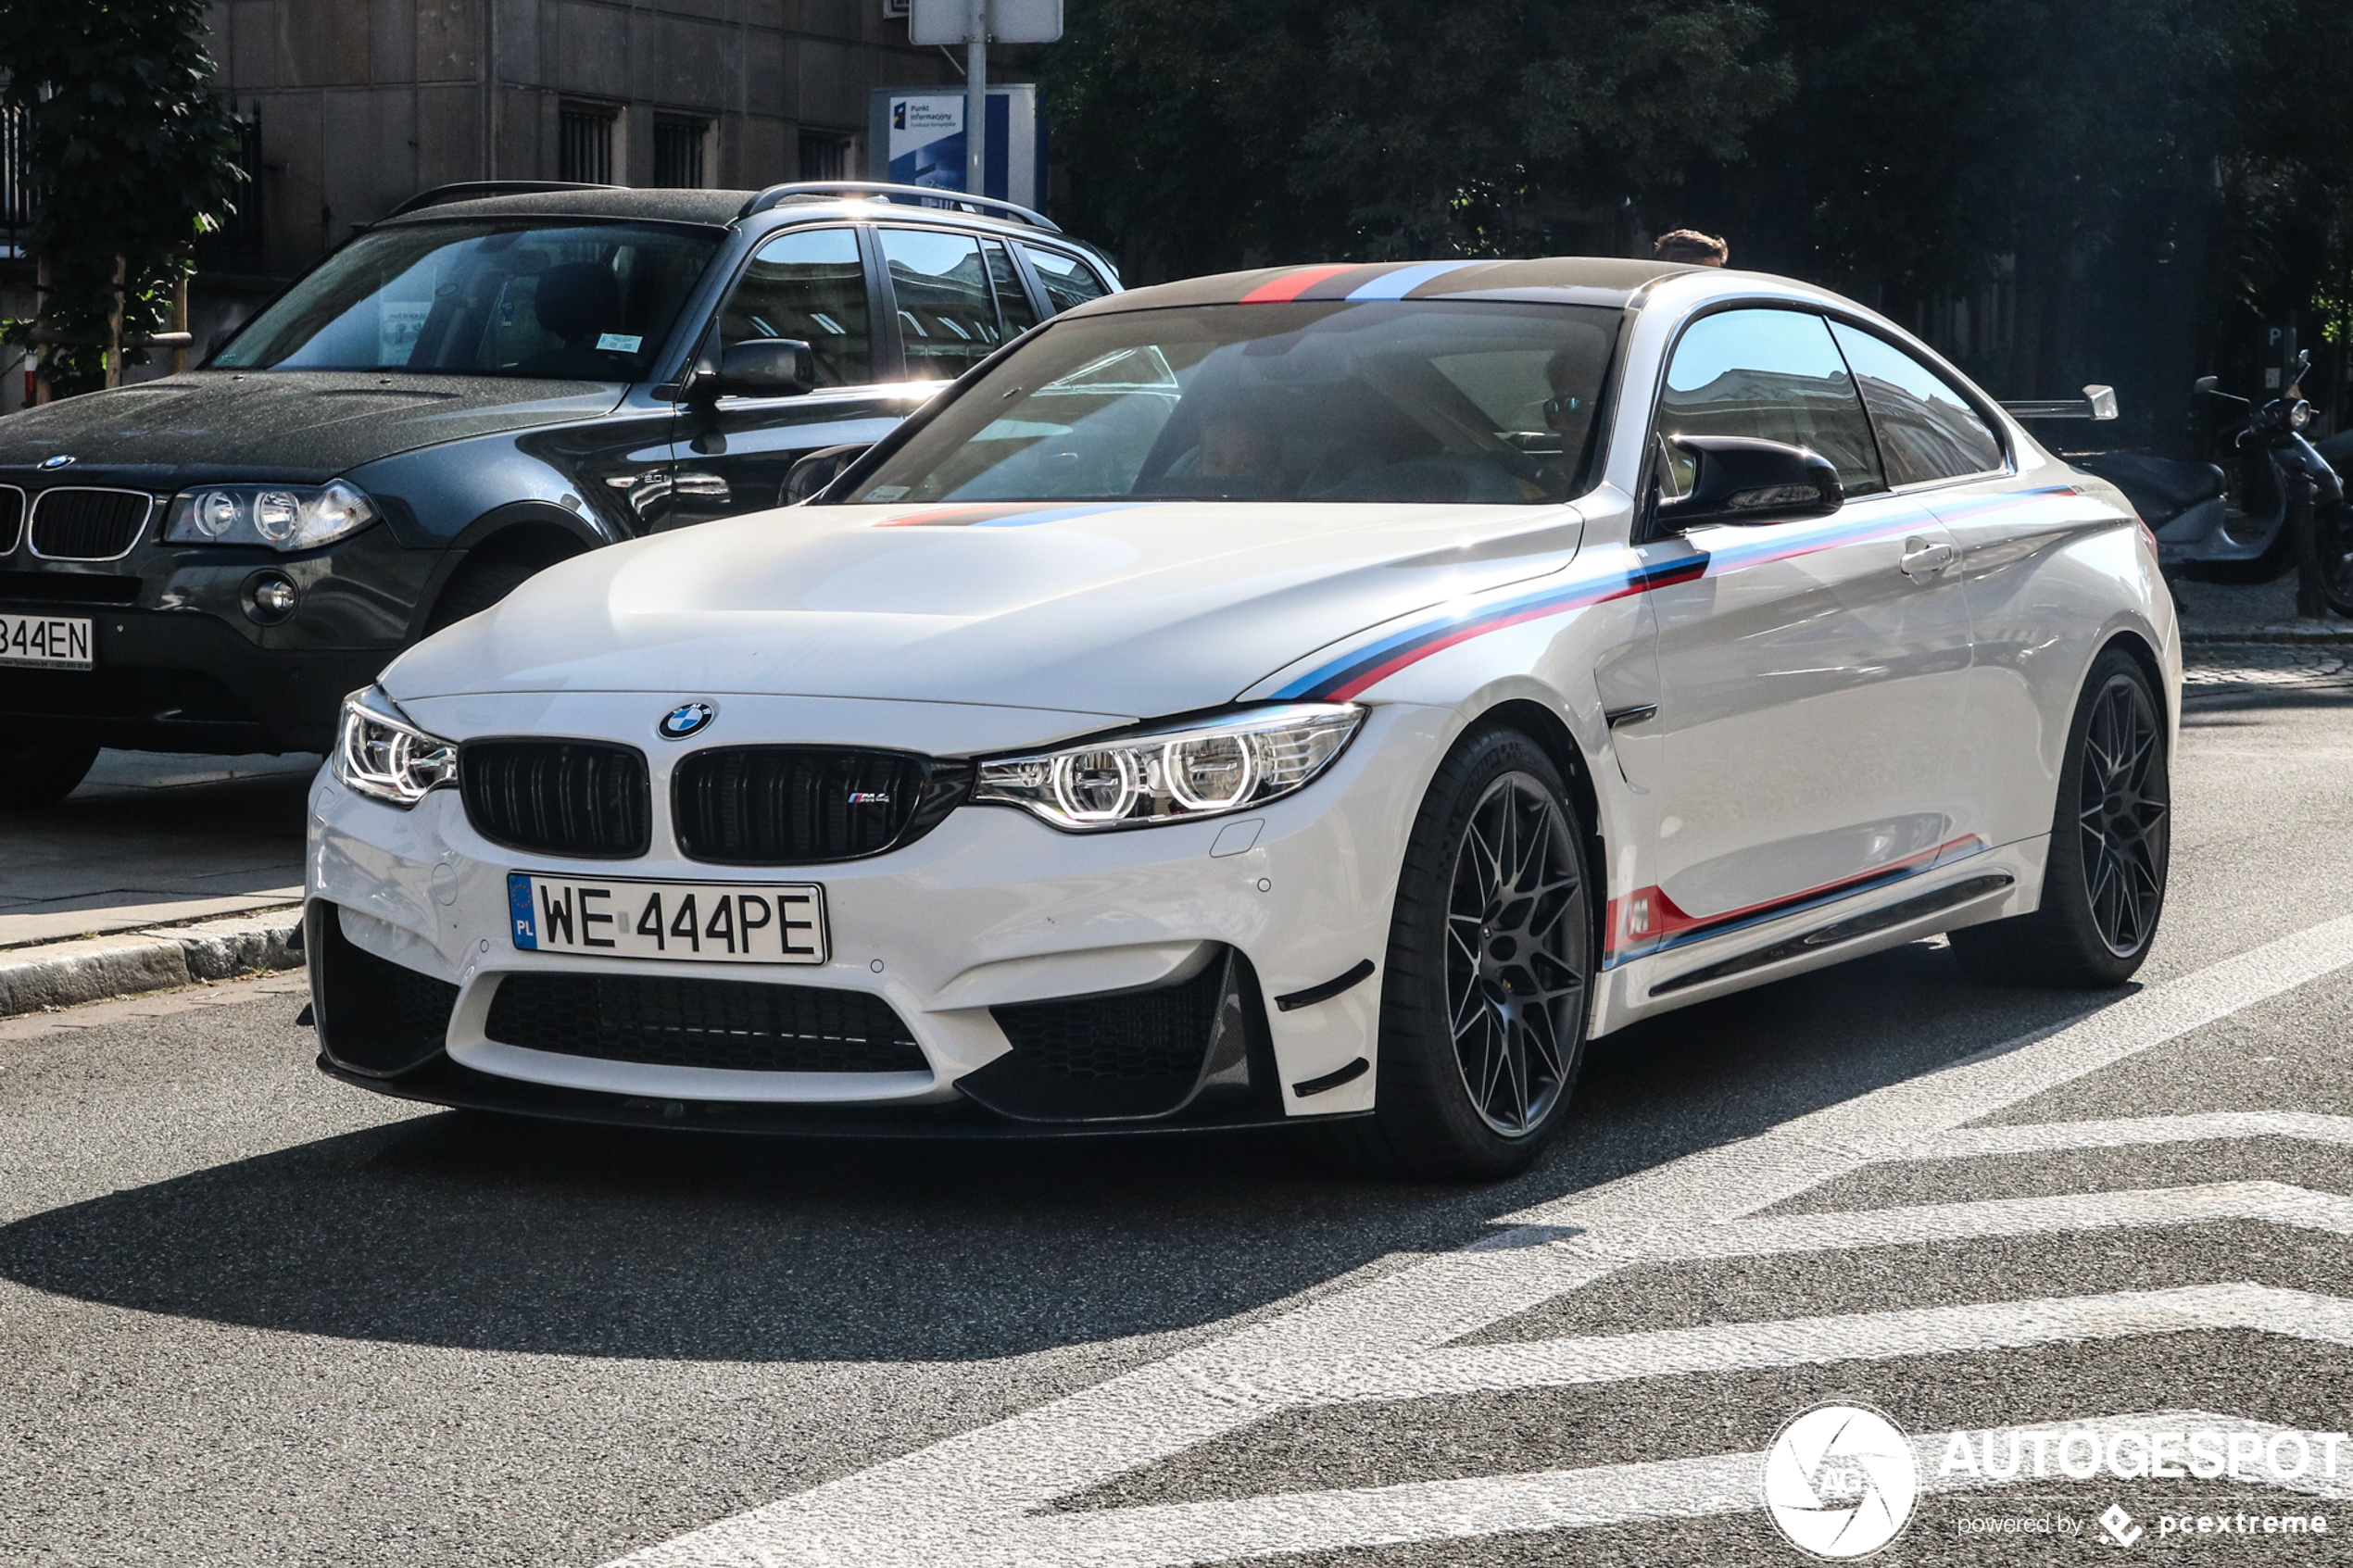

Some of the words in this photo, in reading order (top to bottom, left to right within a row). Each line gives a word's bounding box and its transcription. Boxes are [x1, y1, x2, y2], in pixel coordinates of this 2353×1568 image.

[2270, 327, 2282, 346] P
[860, 792, 890, 803] M4
[516, 920, 535, 936] PL
[540, 884, 616, 947] WE
[636, 892, 815, 955] 444PE
